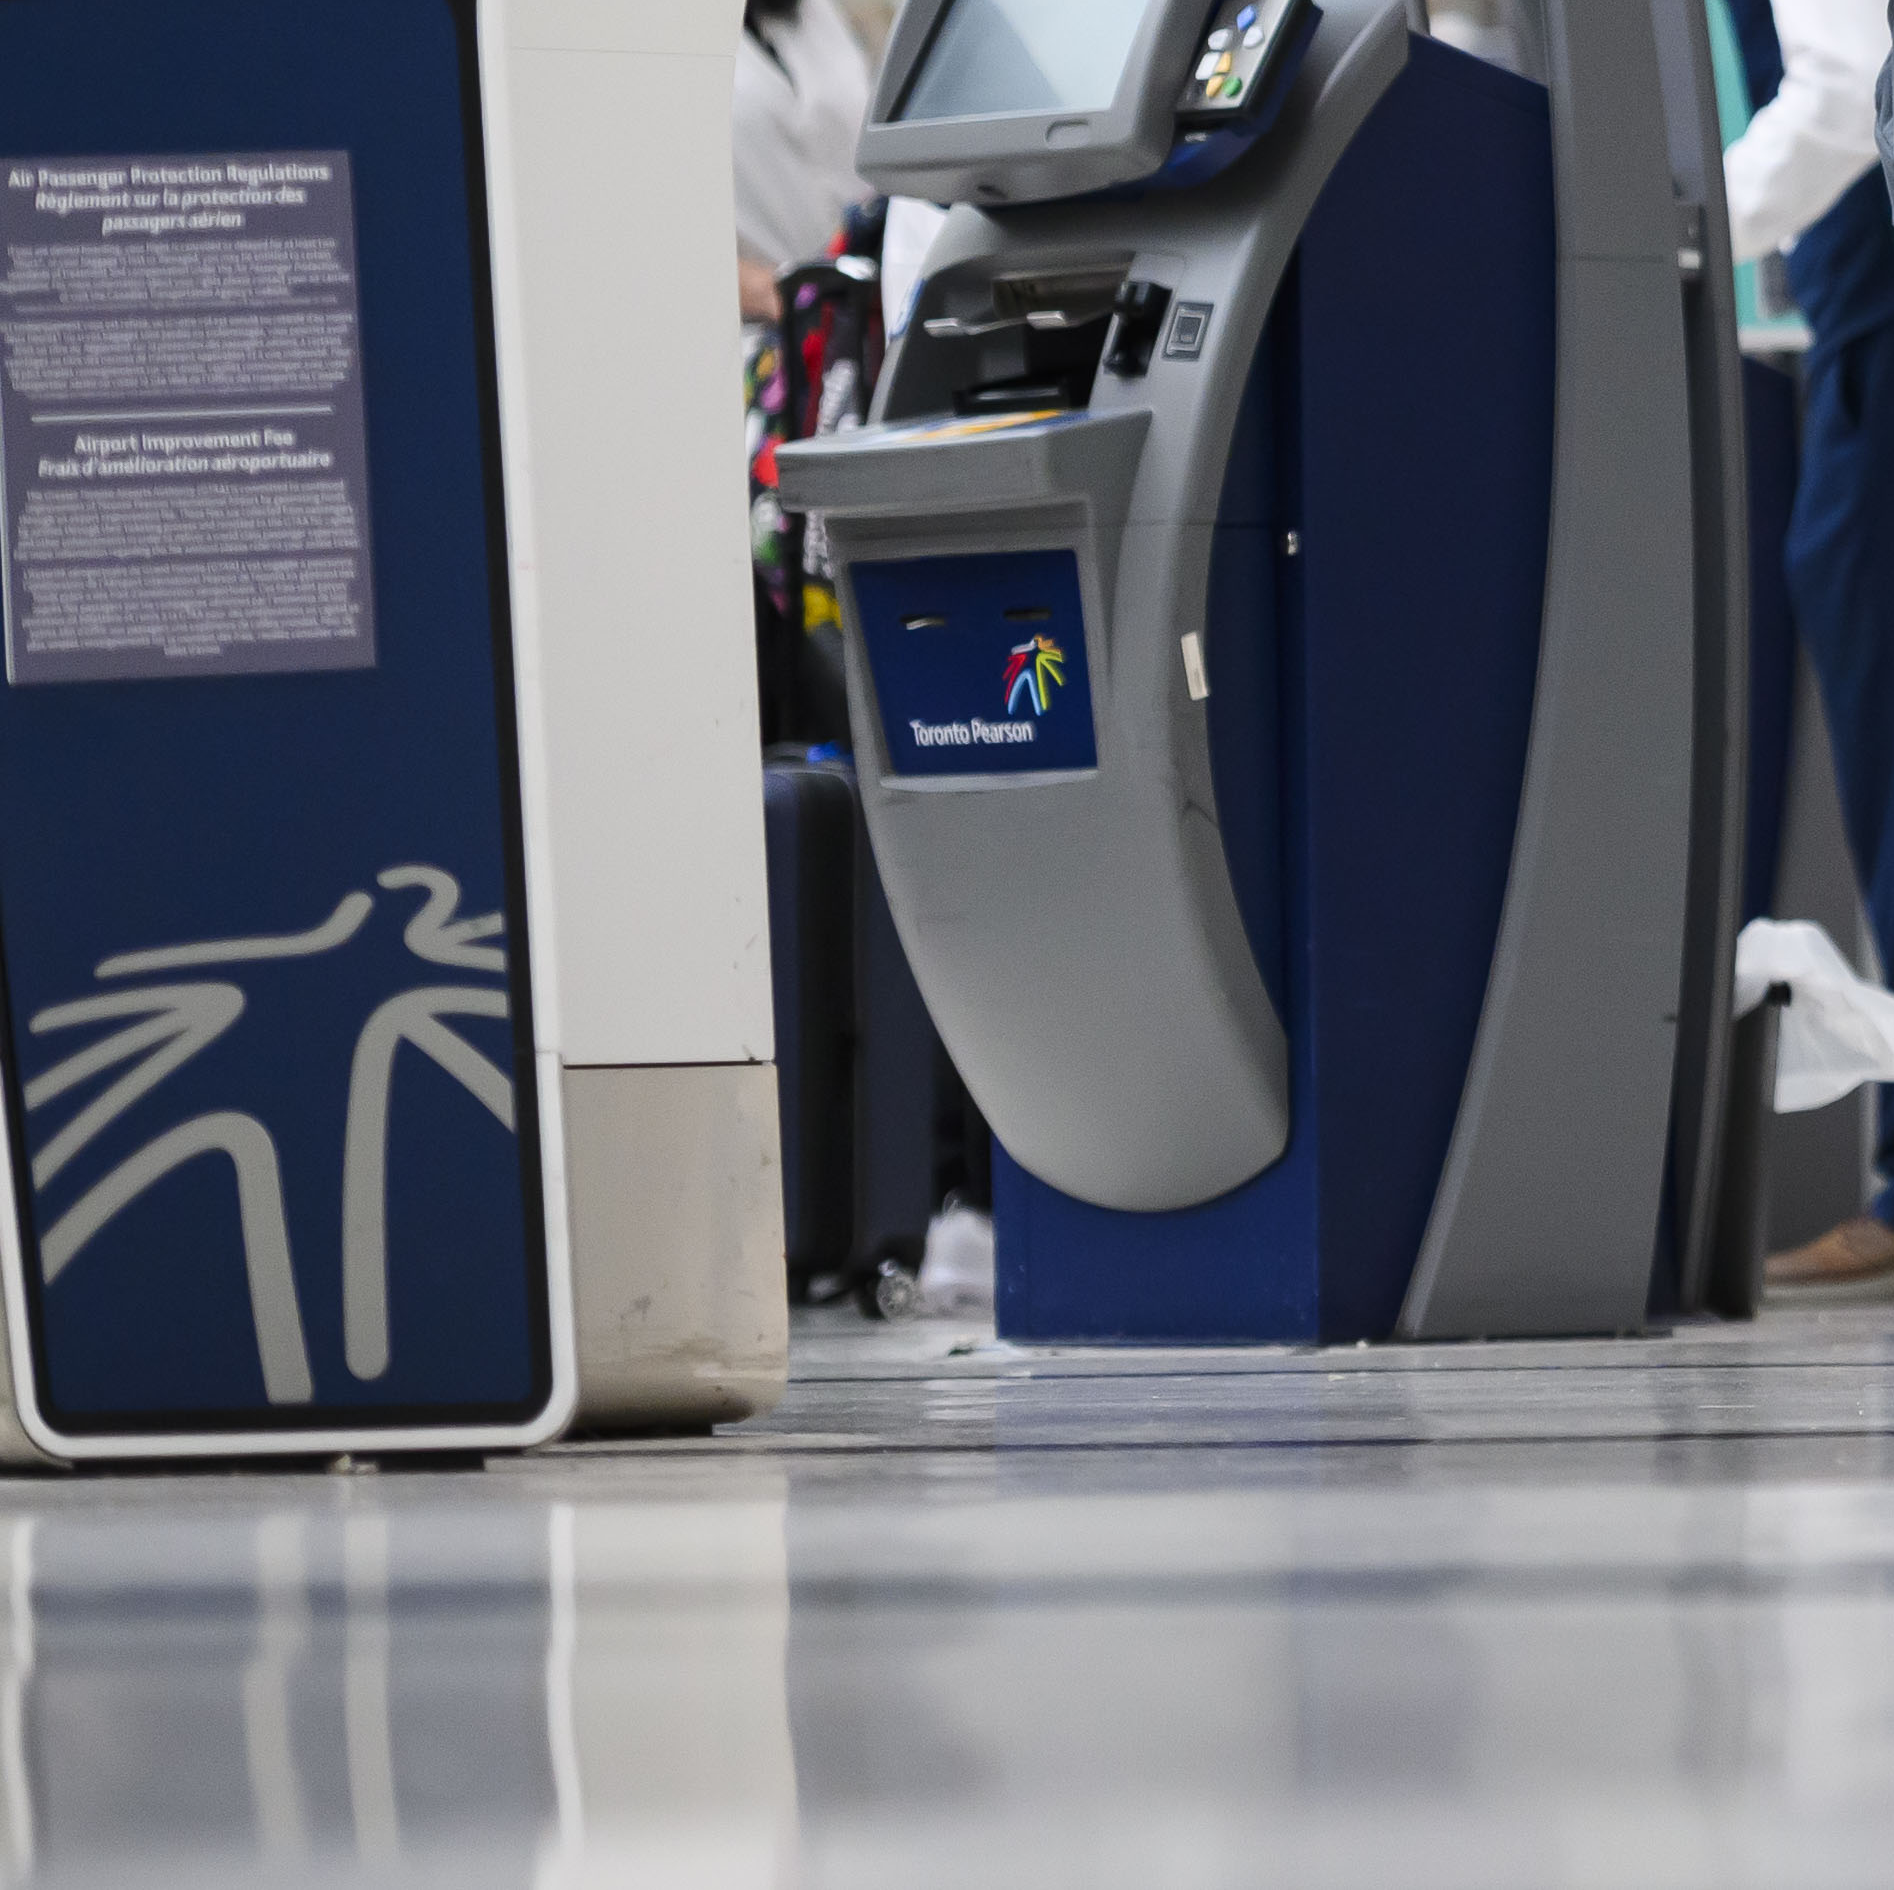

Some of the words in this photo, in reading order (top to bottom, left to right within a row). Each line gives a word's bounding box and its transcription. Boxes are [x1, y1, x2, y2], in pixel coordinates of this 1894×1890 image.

[8, 166, 35, 189] Air
[38, 168, 128, 192] Passenger
[130, 165, 223, 186] Protection
[226, 163, 332, 188] Regulations
[133, 192, 160, 208] sur
[162, 187, 179, 207] la
[181, 187, 272, 211] protection
[275, 185, 307, 204] des
[102, 214, 186, 237] passagers
[74, 433, 139, 456] Airport
[141, 431, 261, 456] Improvement
[263, 427, 296, 447] Fee
[909, 718, 971, 747] Toronto
[971, 717, 1034, 744] Pearson
